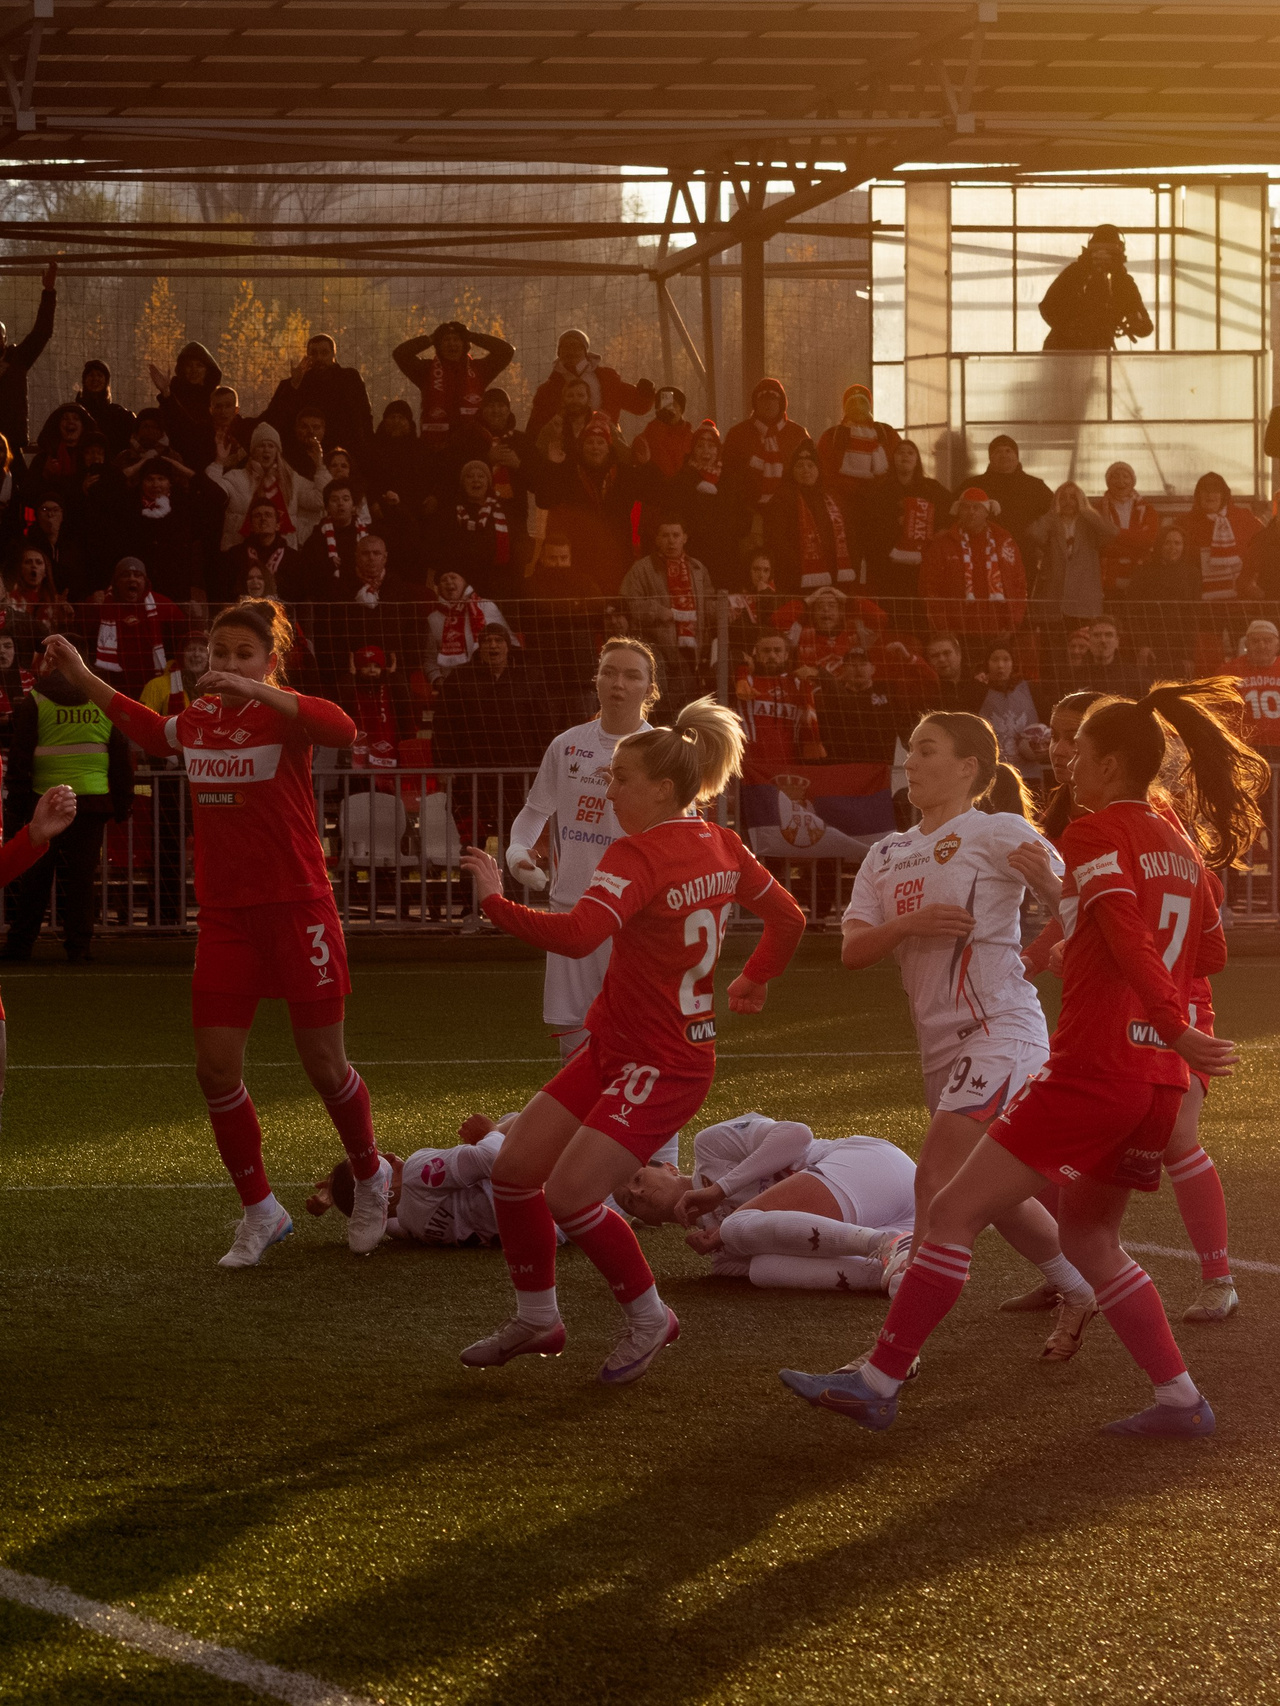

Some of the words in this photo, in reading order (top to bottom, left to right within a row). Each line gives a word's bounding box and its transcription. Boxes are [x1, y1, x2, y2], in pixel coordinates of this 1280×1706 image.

[1245, 690, 1280, 719] 10
[575, 748, 594, 759] ПСБ
[188, 755, 254, 777] ЛУКОЙЛ
[198, 793, 233, 804] WINLINE
[577, 795, 606, 811] FON
[576, 808, 605, 824] BET
[894, 877, 925, 899] FON
[896, 894, 925, 916] BET
[1158, 893, 1191, 972] 7
[306, 923, 330, 967] 3
[600, 1061, 661, 1105] 20
[1125, 1148, 1162, 1160] ЛУКО
